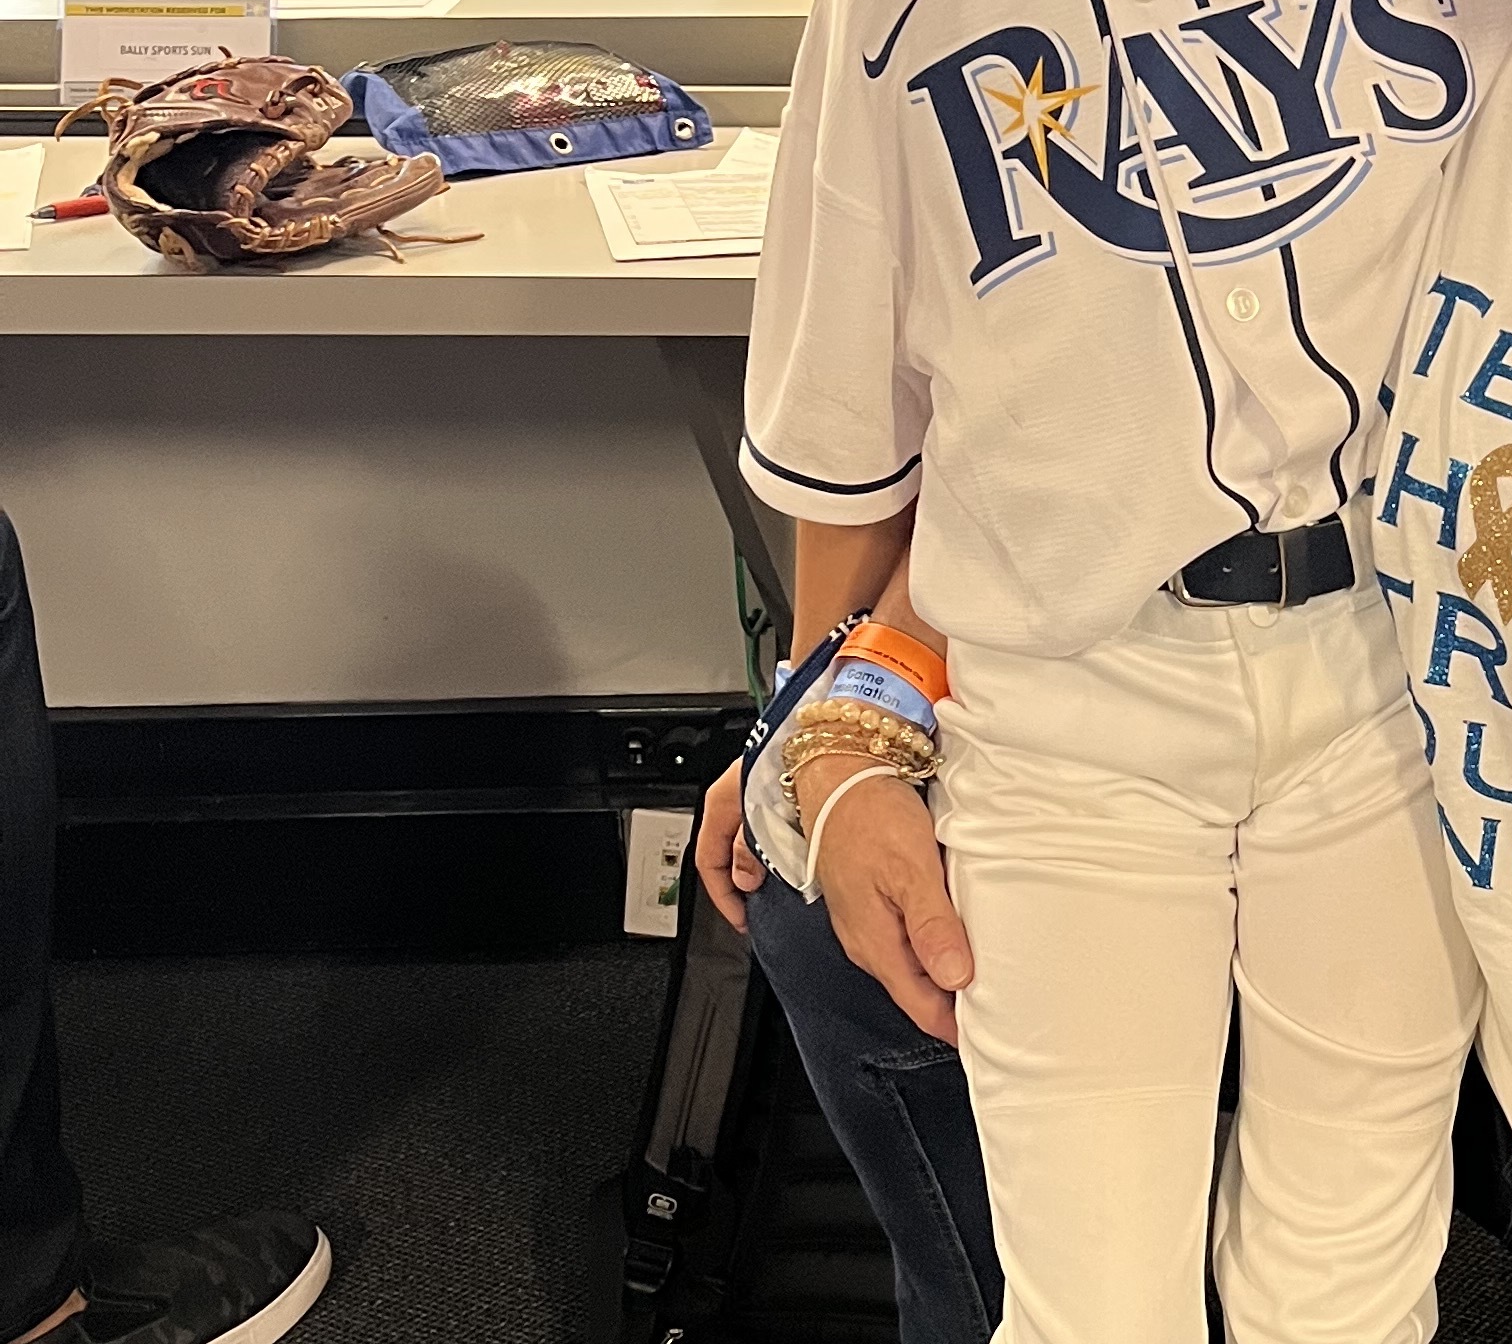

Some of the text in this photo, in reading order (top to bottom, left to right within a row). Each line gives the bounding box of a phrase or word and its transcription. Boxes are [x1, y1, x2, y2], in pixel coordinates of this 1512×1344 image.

[120, 45, 212, 56] BALLY SPORTS SUN
